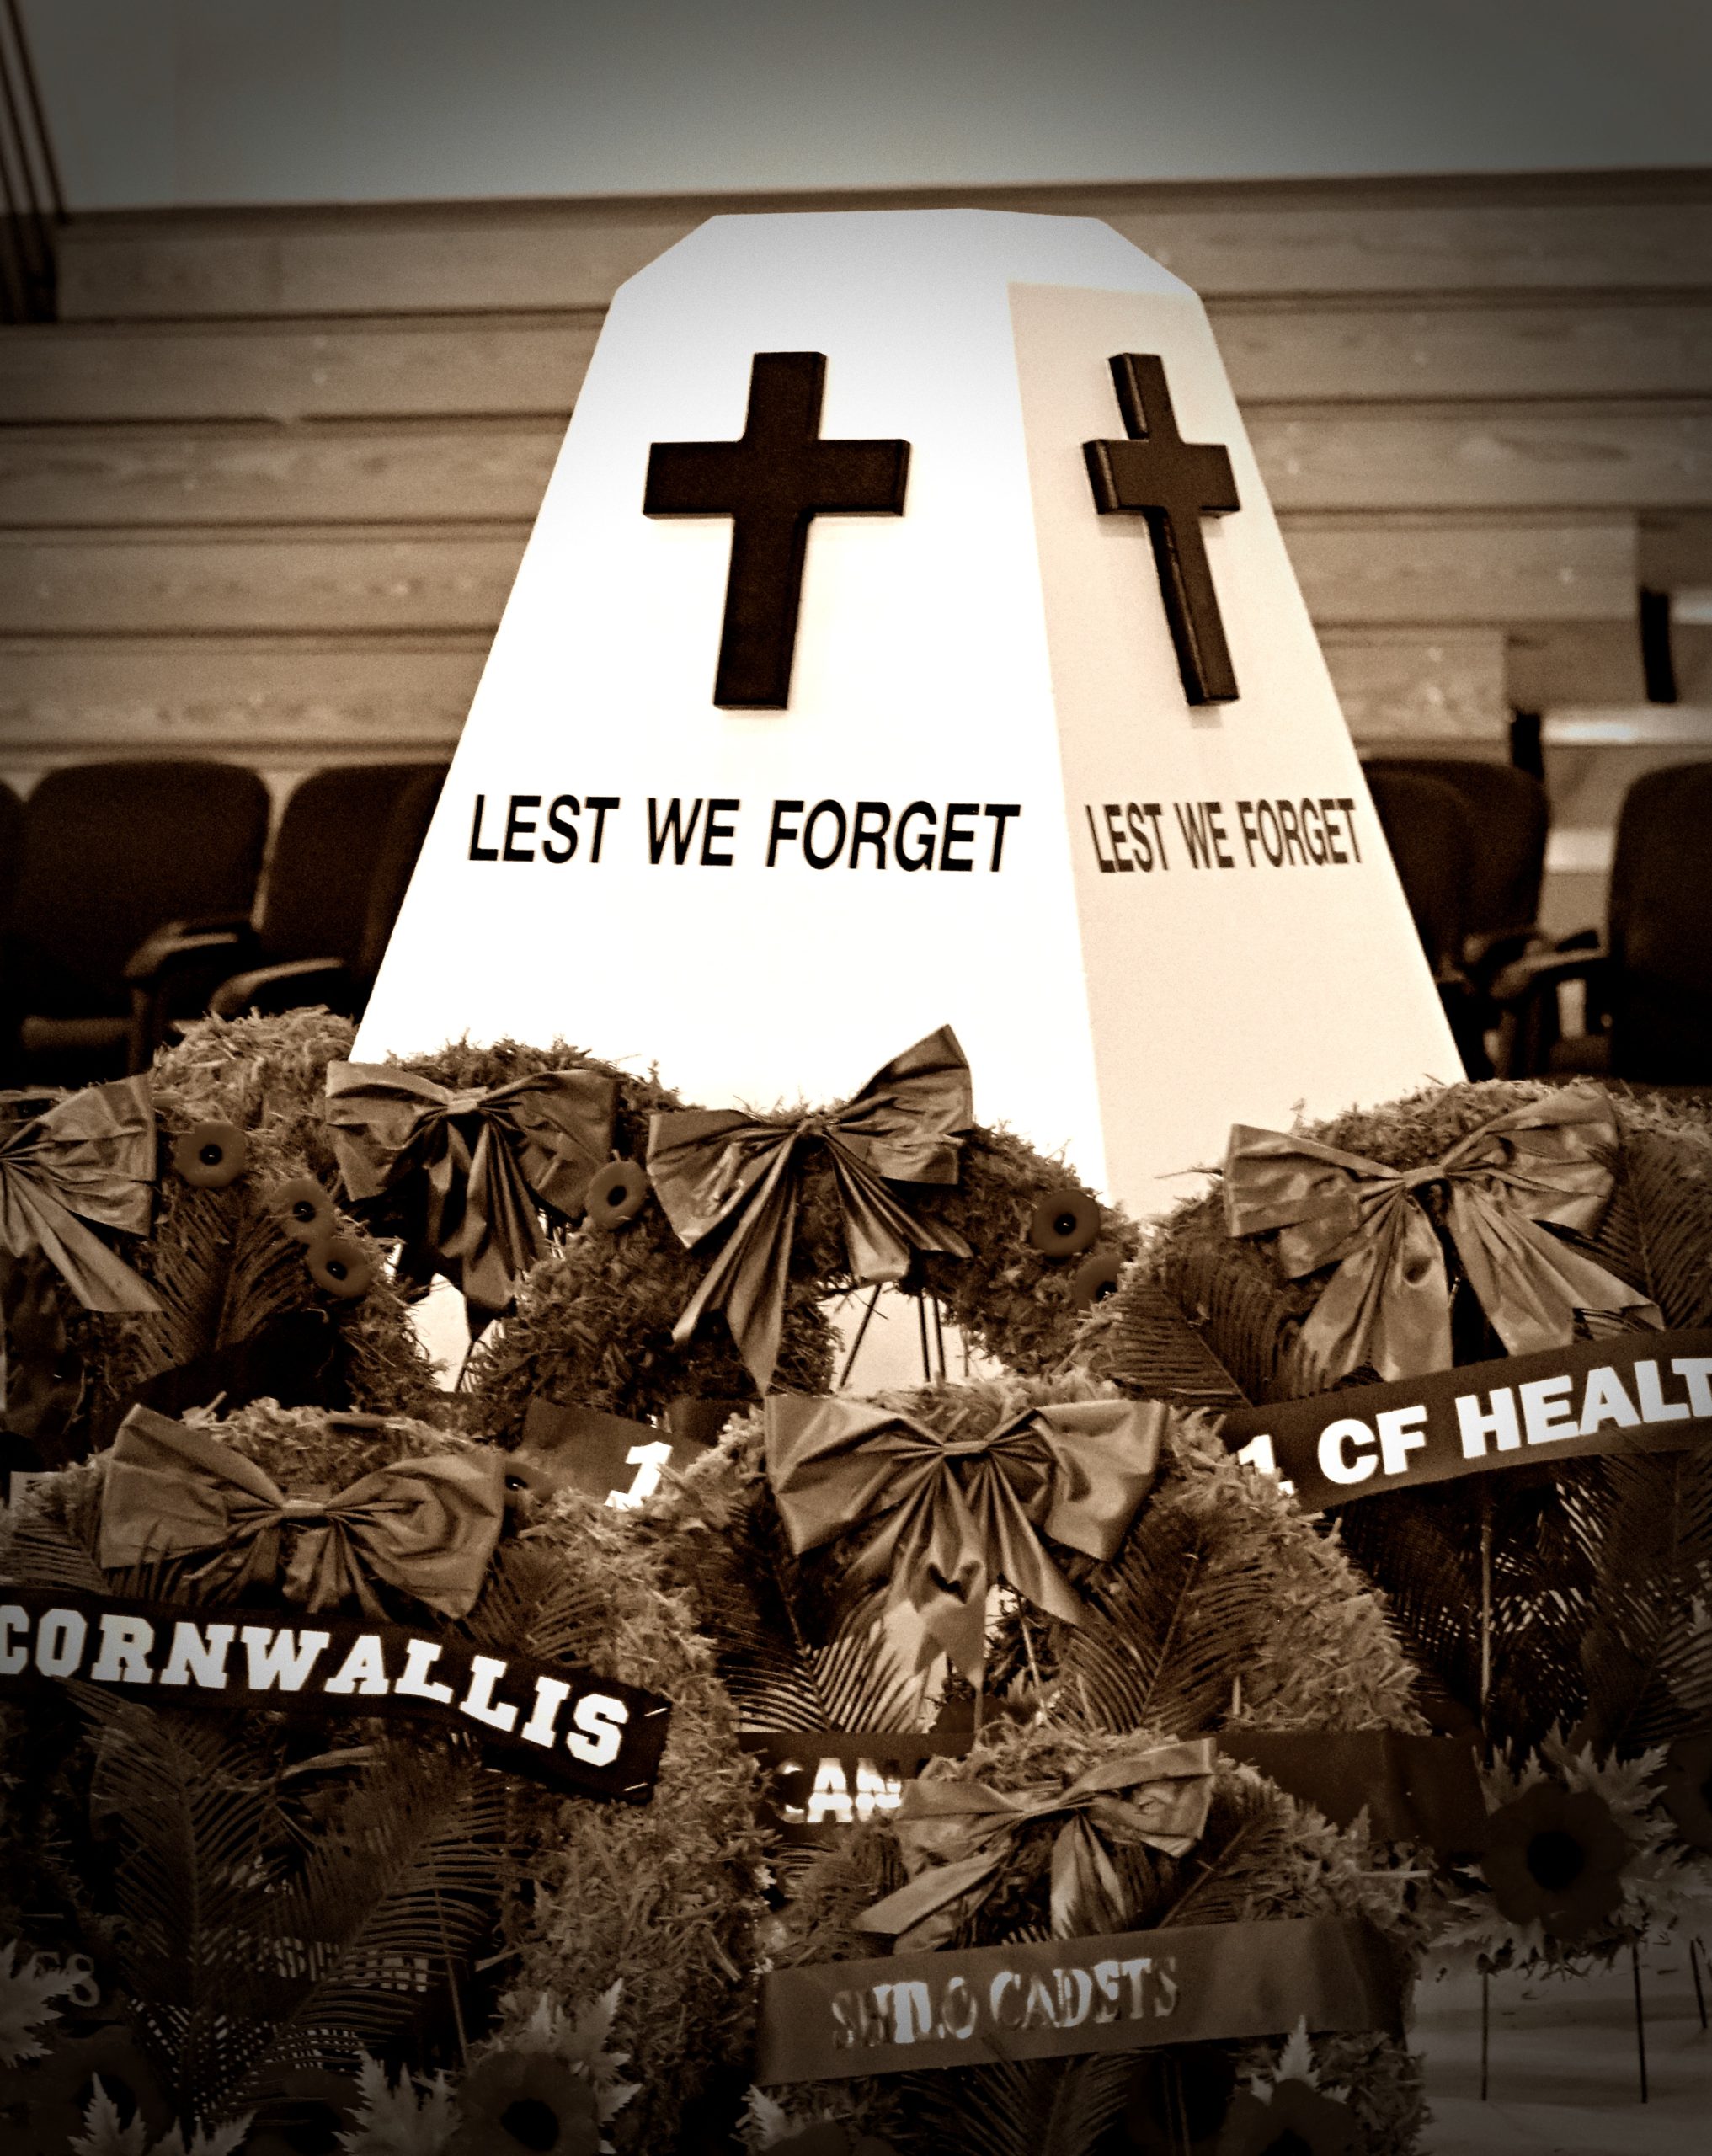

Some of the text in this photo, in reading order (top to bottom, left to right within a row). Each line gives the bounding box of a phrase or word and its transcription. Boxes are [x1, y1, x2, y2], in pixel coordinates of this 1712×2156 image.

[468, 794, 1021, 873] LEST WE FORGET
[1085, 798, 1361, 873] LEST WE FORGET
[1318, 1405, 1427, 1485] CF
[0, 1604, 629, 1768] CORNWALLIS
[989, 1956, 1177, 2031] CADETS
